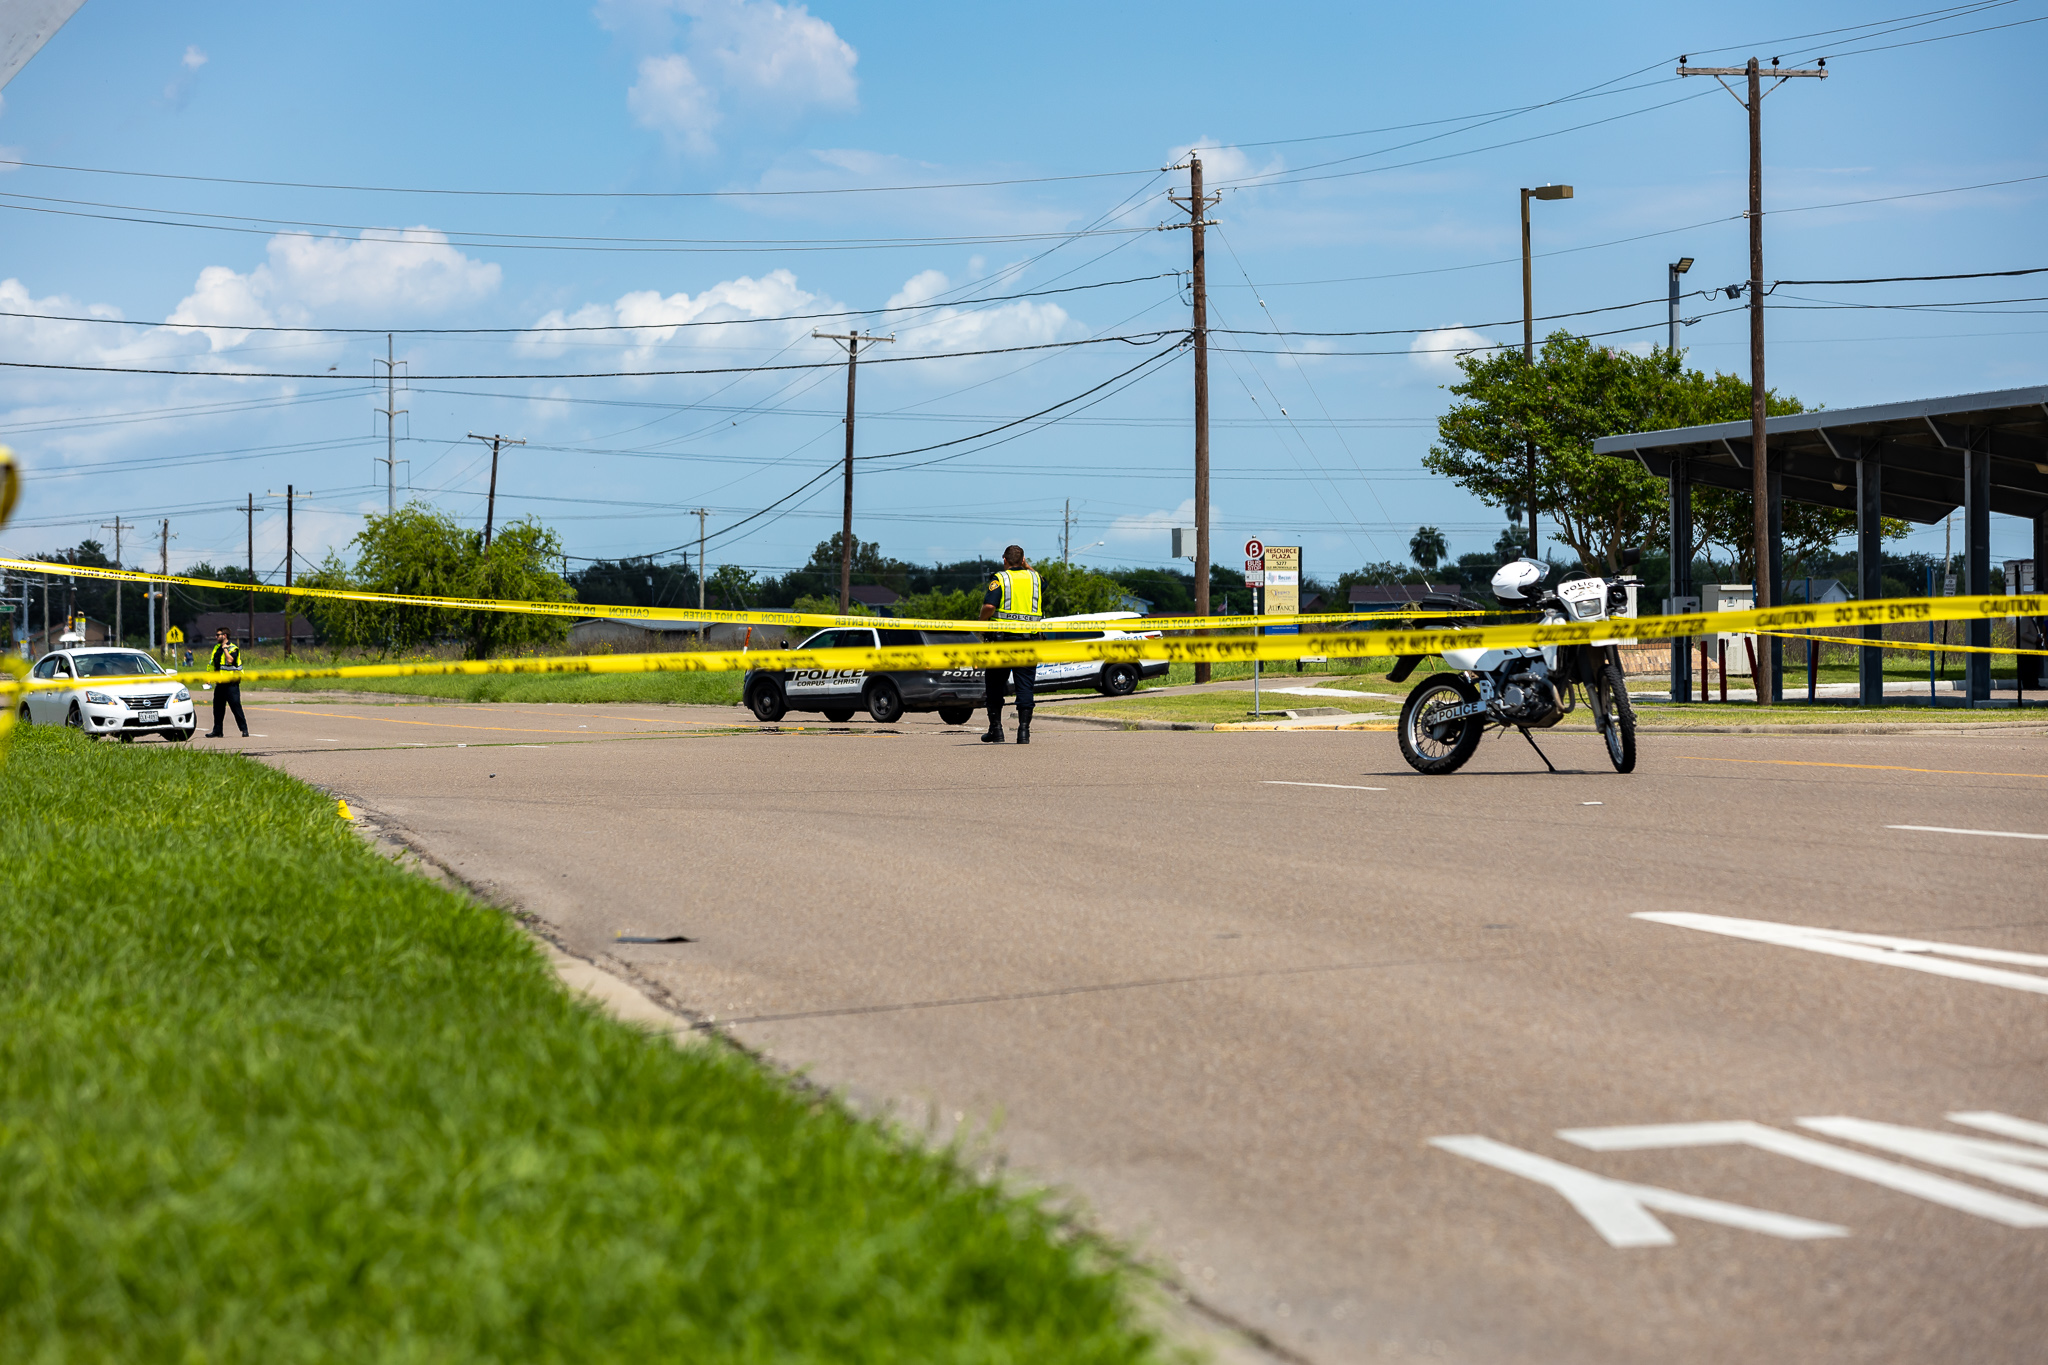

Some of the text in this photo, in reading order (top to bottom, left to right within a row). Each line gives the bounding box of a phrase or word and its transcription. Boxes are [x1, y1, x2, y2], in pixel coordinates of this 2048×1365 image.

[1563, 581, 1602, 595] POLICE
[1835, 603, 1932, 622] DO NOT ENTER
[1980, 599, 2042, 614] CAUTION
[1006, 614, 1034, 622] POLICE
[1755, 610, 1817, 627] CAUTION
[1386, 634, 1485, 652] DO NOT ENTER
[794, 668, 863, 681] POLICE
[832, 678, 861, 686] CHRISTI
[1438, 702, 1478, 720] POLICE
